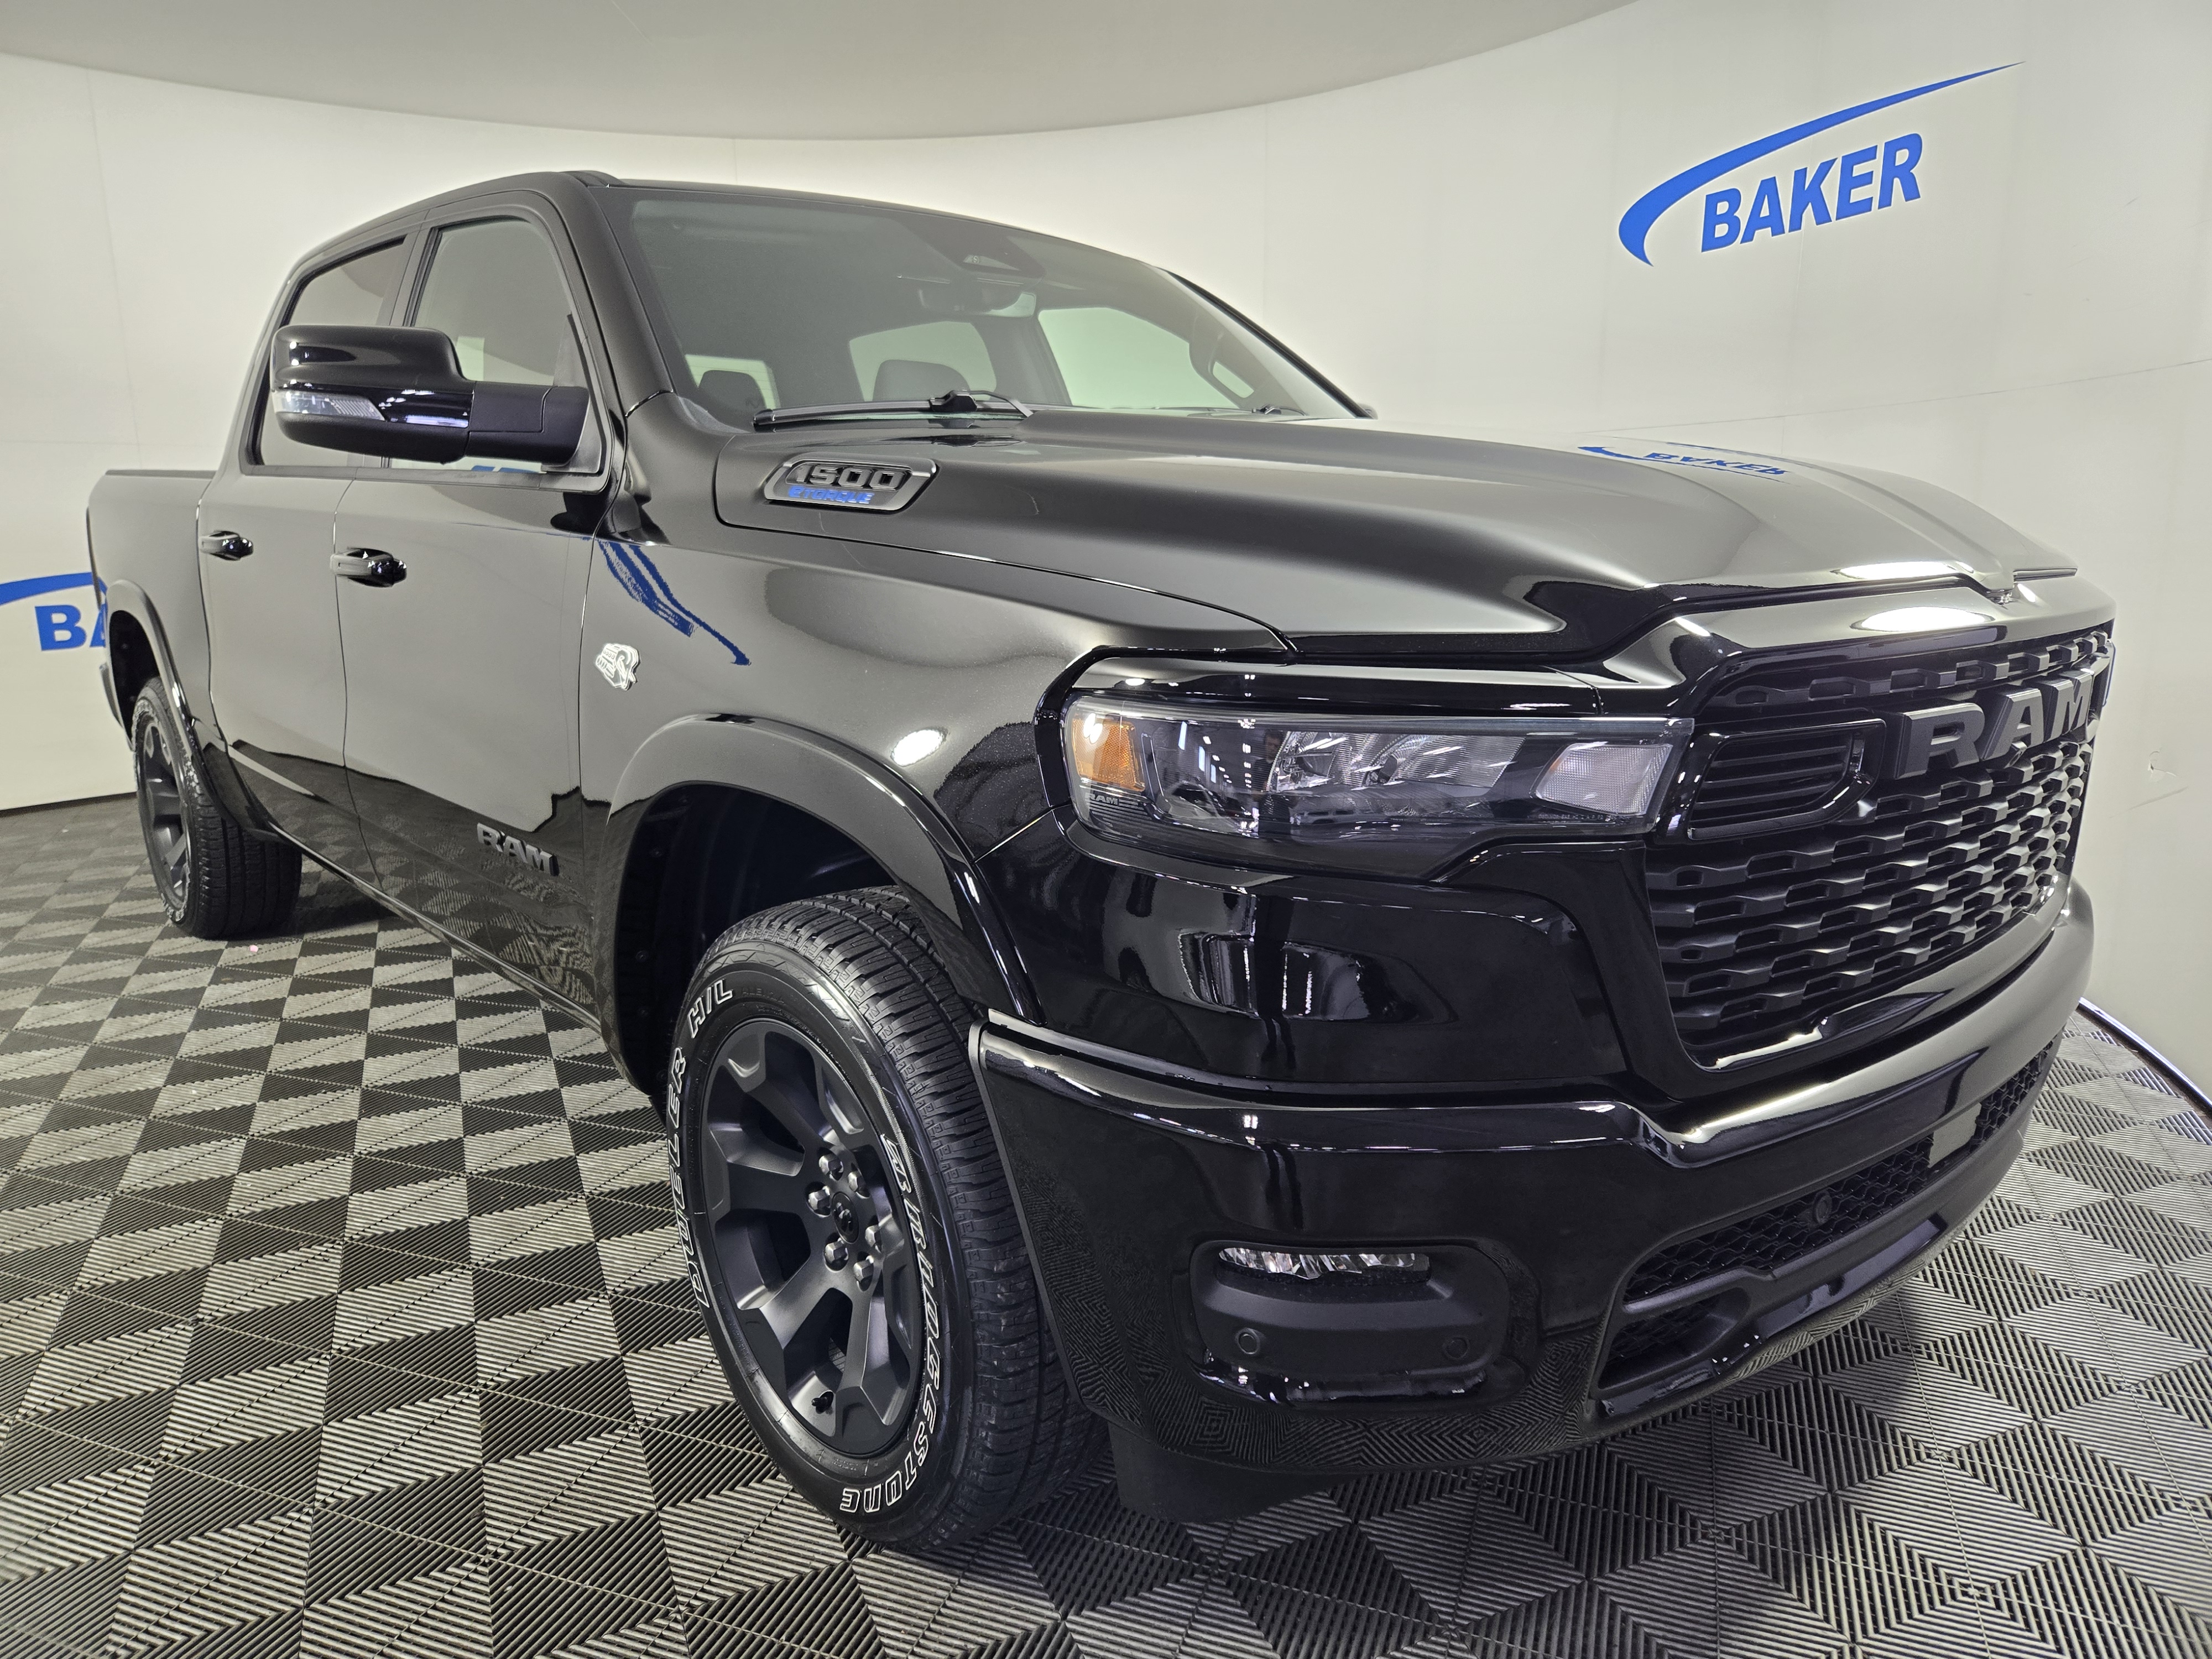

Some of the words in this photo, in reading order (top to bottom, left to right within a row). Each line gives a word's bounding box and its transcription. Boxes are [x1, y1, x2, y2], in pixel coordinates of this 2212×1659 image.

[1701, 133, 1923, 253] BAKER
[795, 463, 909, 490] 1500
[1895, 667, 2095, 780] RAM
[477, 822, 559, 877] RAM
[1084, 792, 1118, 805] RAM
[667, 1047, 710, 1308] DUELER
[839, 1134, 940, 1513] BRIDGESTONE
